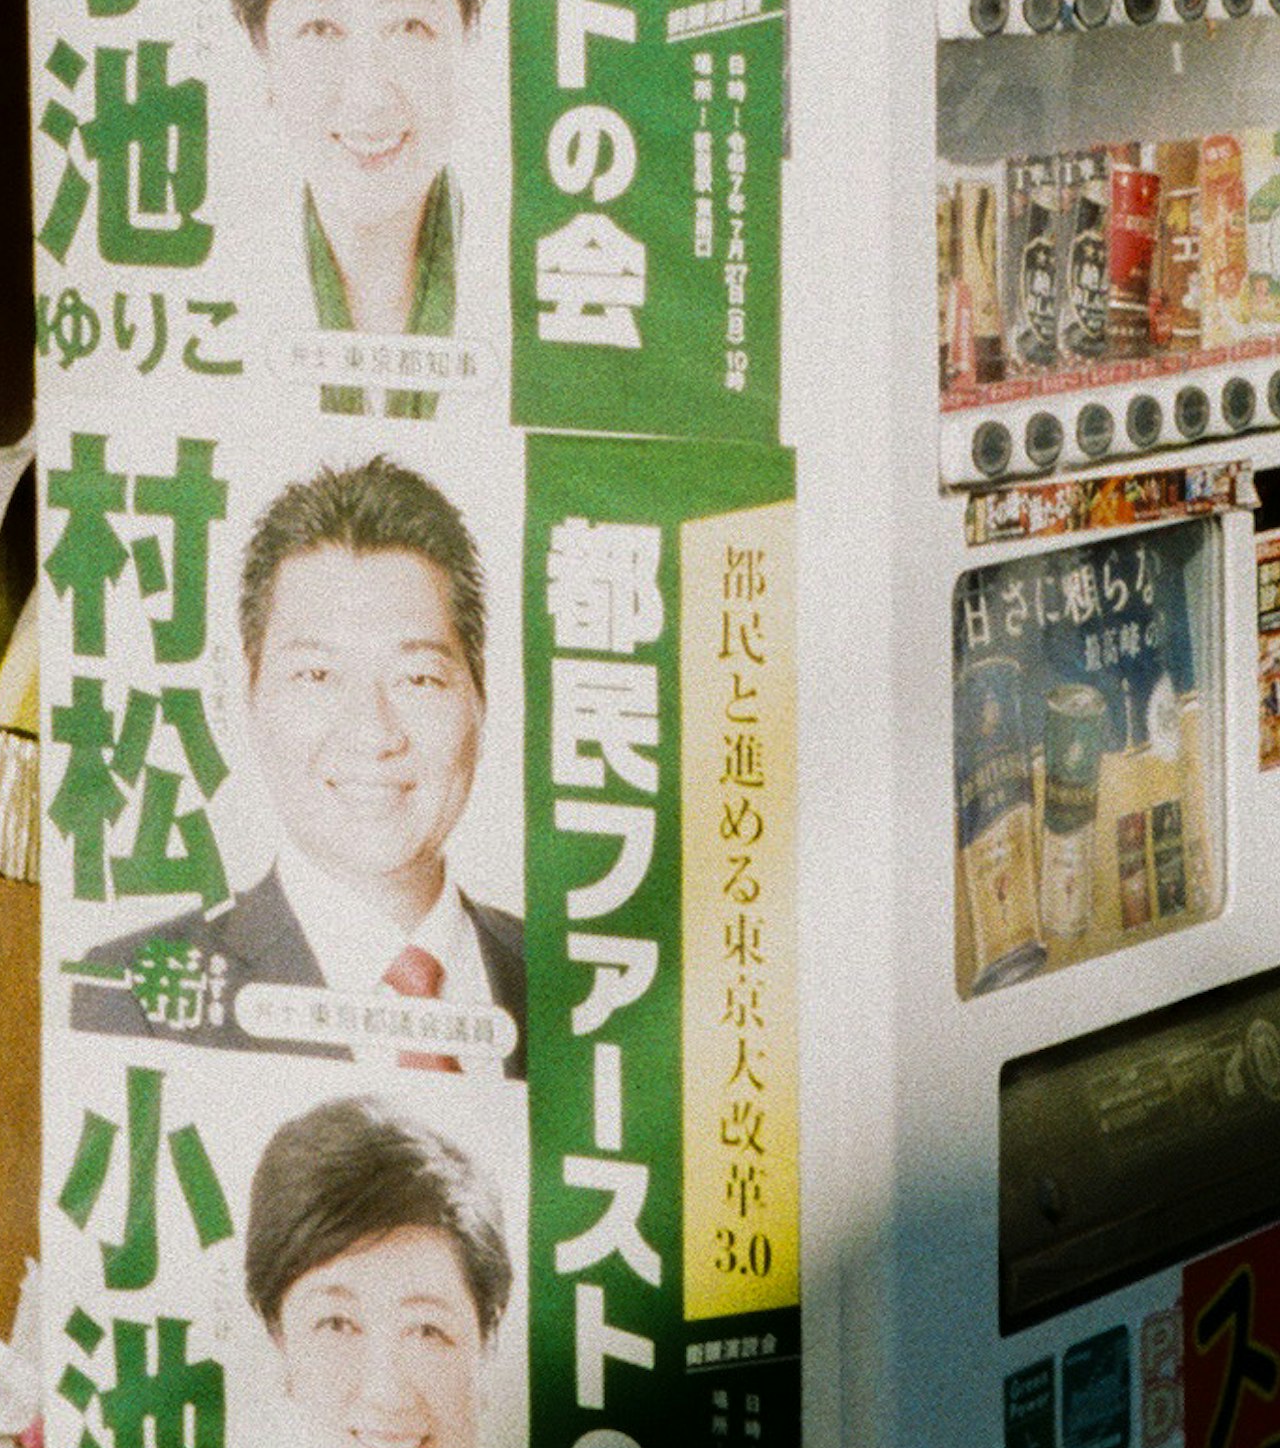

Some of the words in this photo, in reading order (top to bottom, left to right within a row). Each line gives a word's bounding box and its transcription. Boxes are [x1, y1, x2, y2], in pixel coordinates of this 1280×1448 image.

[37, 286, 245, 376] ゆりこ
[44, 431, 235, 919] 村松
